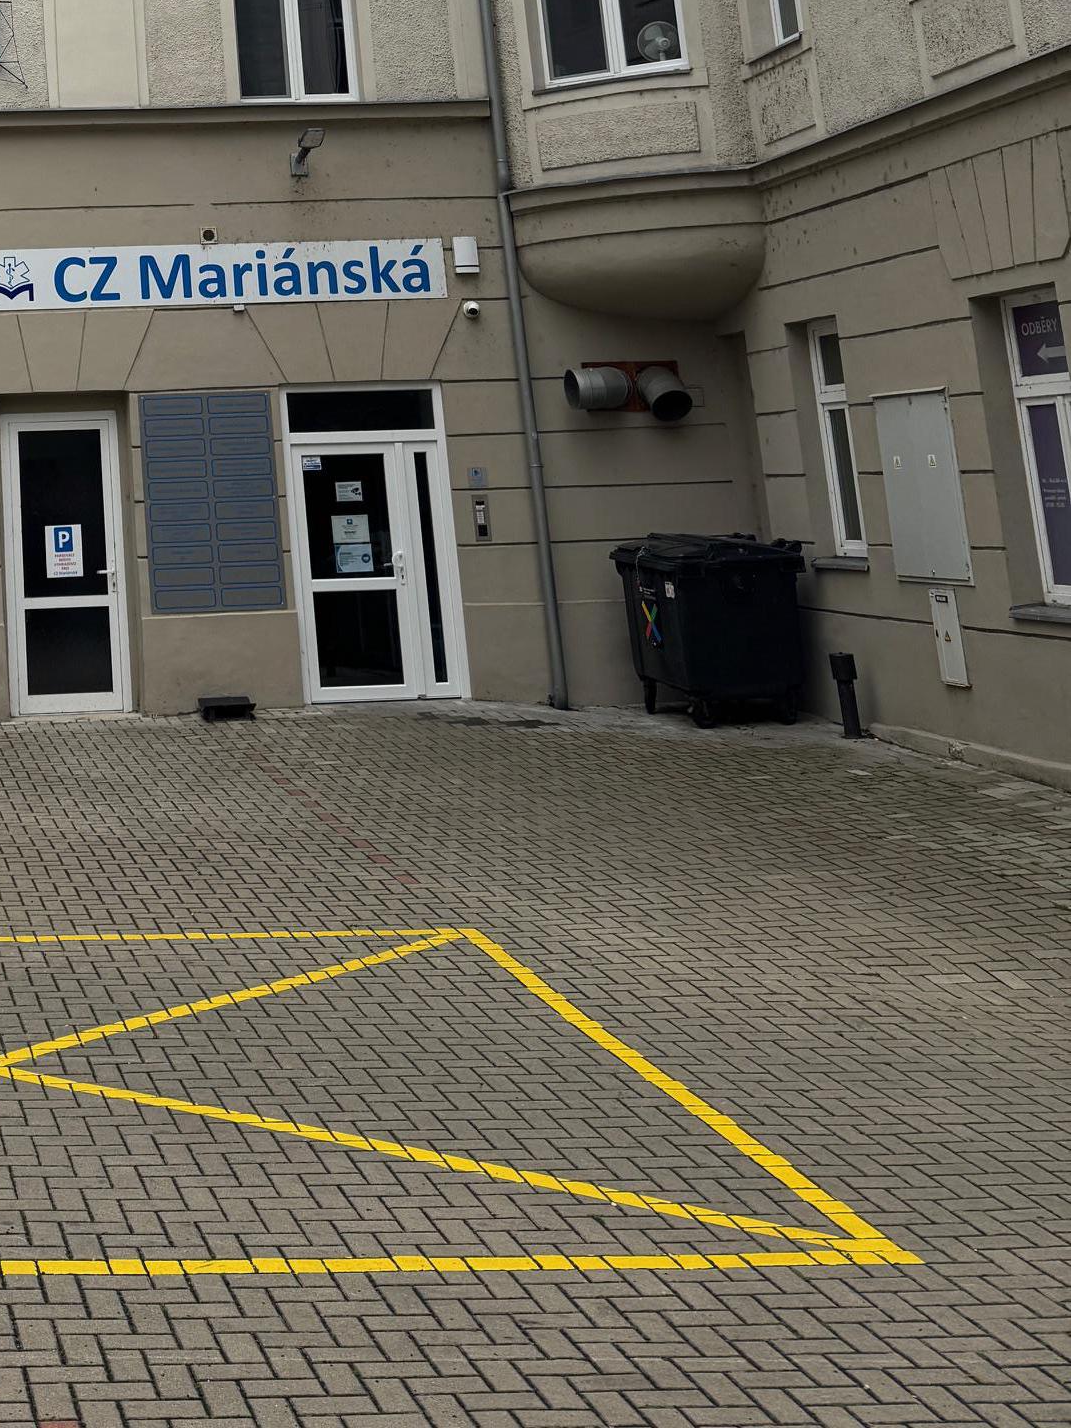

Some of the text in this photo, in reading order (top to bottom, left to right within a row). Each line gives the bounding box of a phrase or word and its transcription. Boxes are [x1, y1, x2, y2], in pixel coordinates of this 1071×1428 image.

[53, 245, 431, 301] CZ Mariánská
[1021, 316, 1057, 336] ODBĚRY
[59, 531, 70, 548] P
